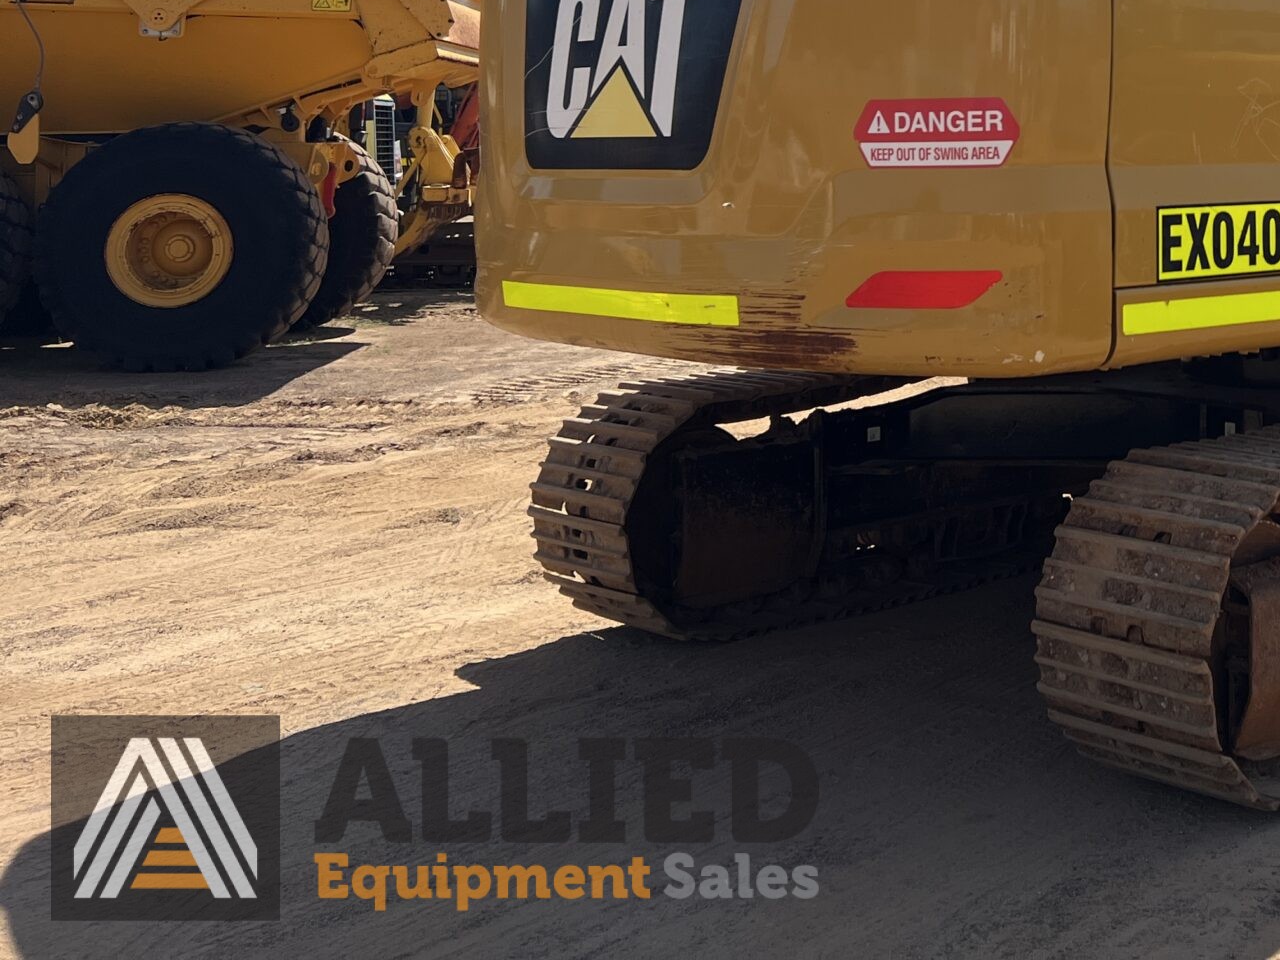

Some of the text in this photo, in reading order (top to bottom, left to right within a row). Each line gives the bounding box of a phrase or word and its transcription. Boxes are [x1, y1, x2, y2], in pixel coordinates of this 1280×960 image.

[894, 110, 1003, 133] DANGER
[870, 146, 1000, 161] KEEP OUT OF SWING AREA
